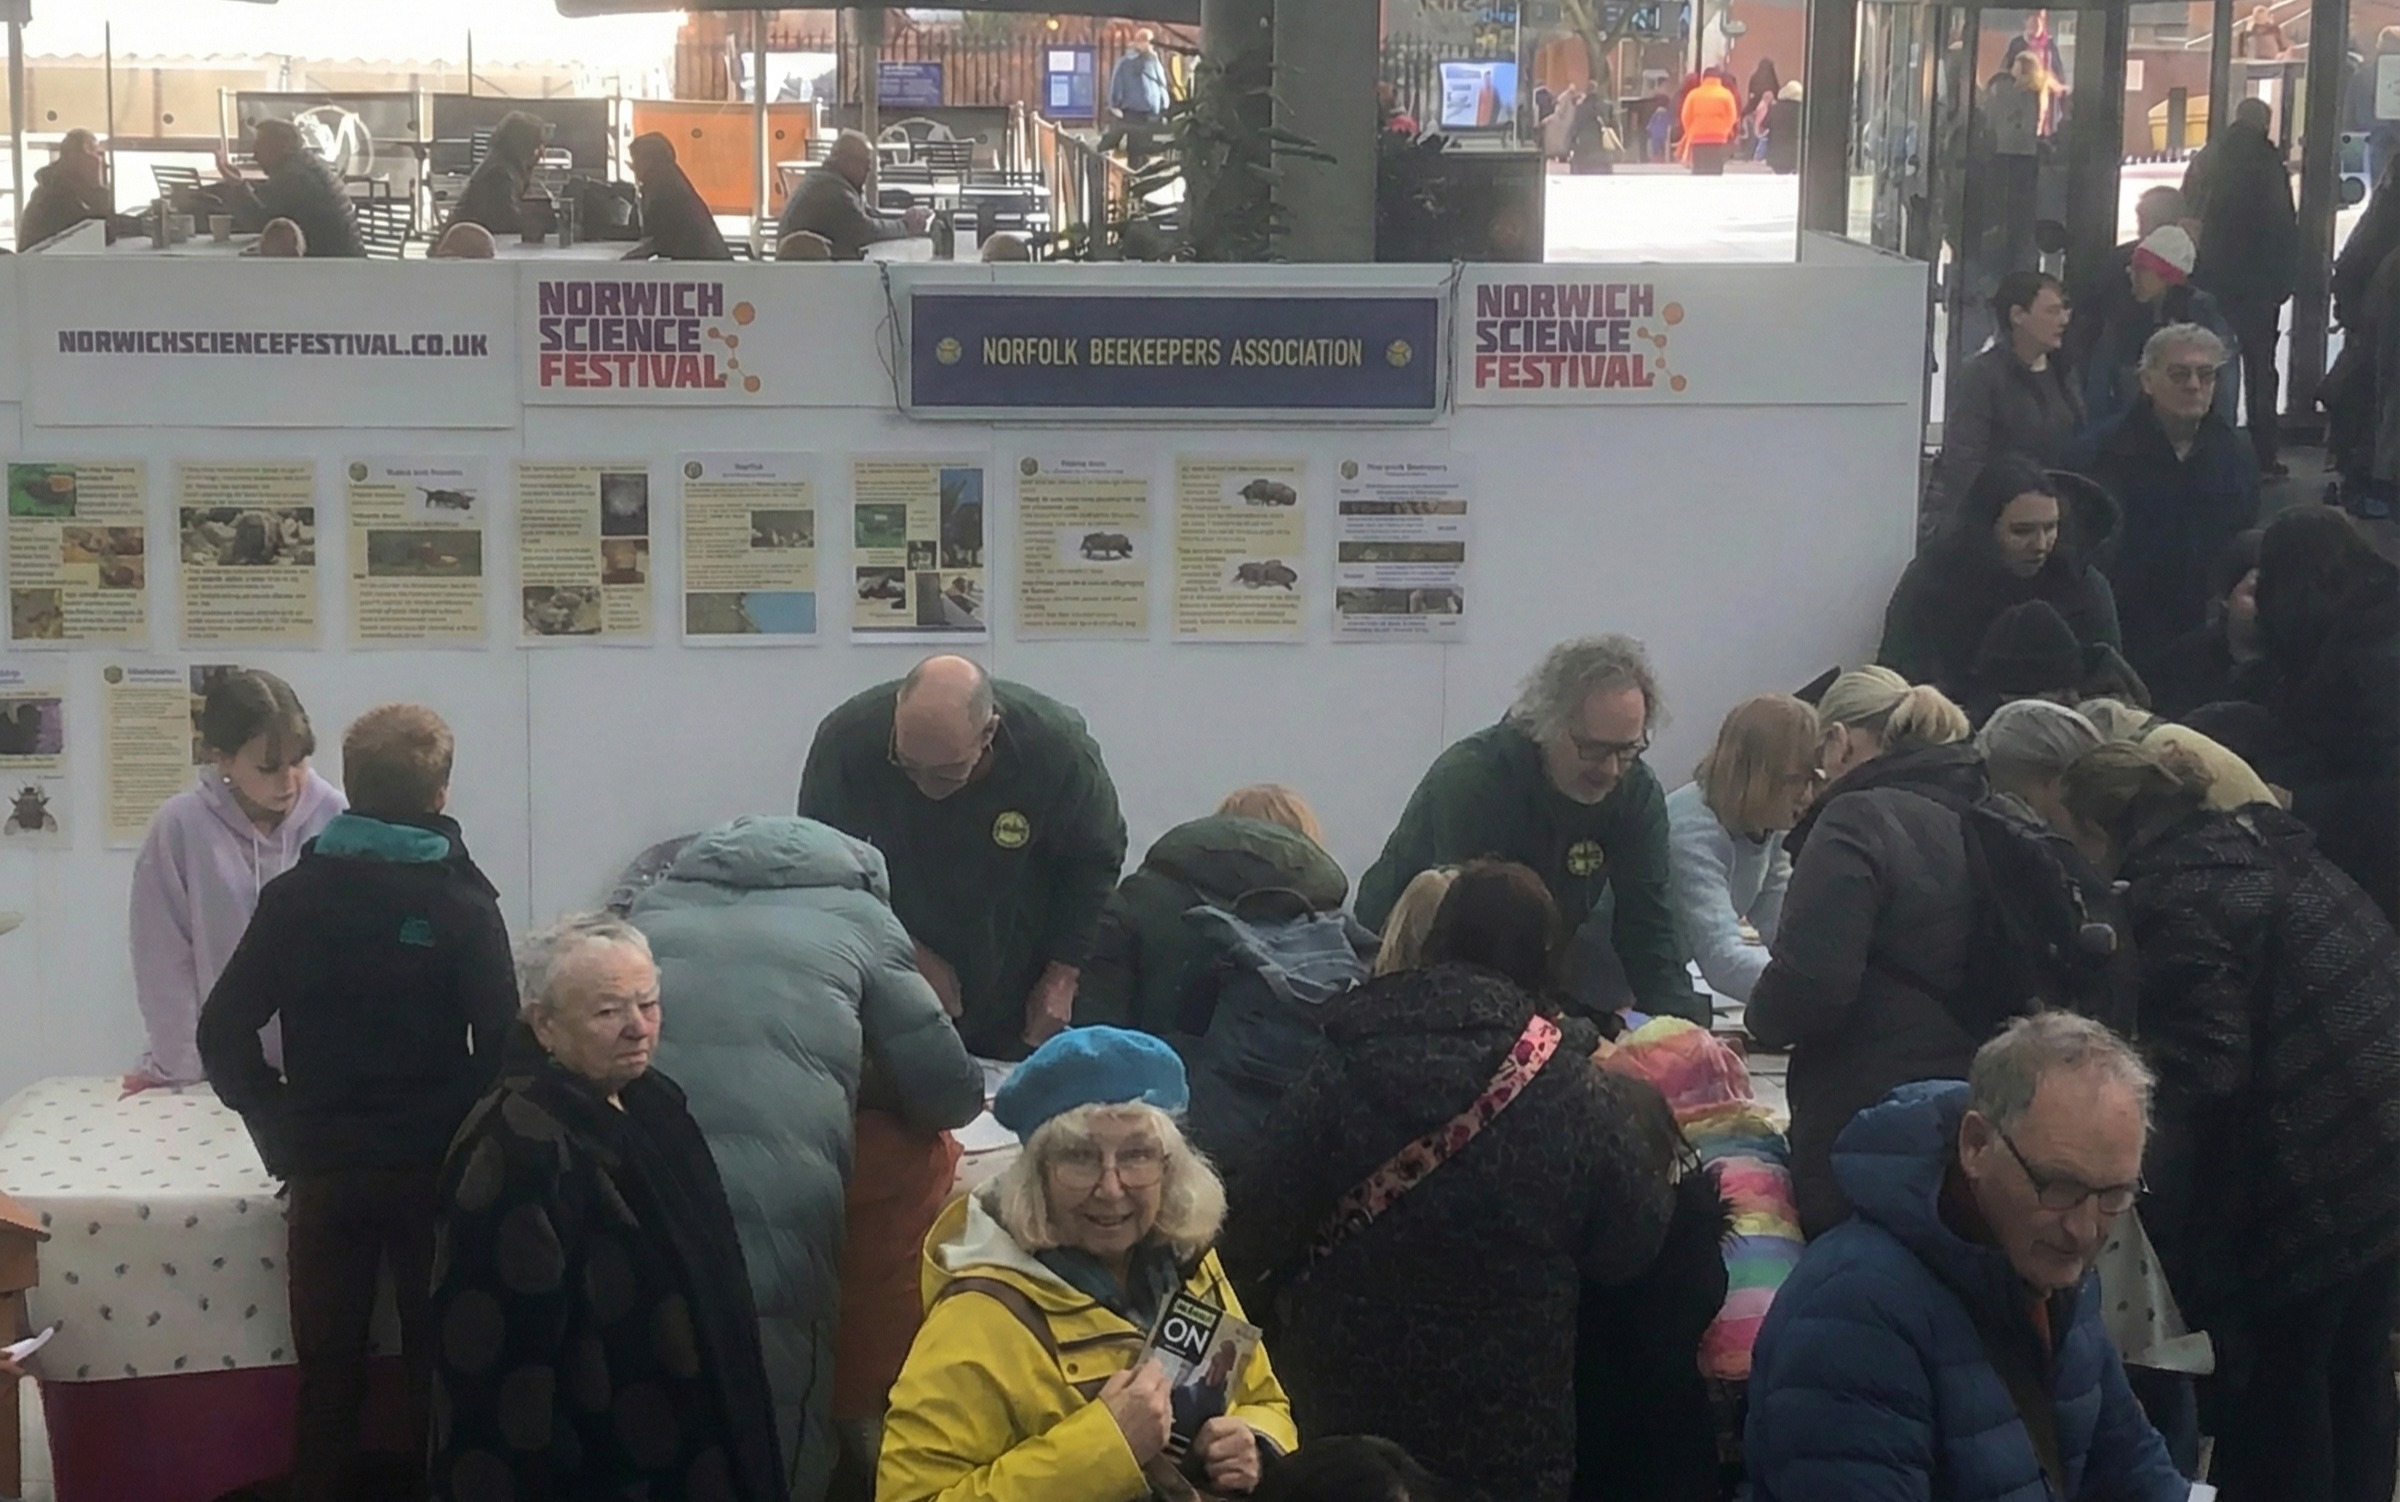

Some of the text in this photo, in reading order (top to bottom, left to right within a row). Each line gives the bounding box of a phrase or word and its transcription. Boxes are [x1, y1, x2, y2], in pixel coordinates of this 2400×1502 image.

[538, 281, 724, 317] NORWICH
[1475, 283, 1654, 318] NORWICH
[58, 330, 488, 357] NORWICHSCIENCEFESTIVAL.CO.UK
[538, 317, 702, 353] SCIENCE
[982, 337, 1362, 367] NORFOLK BEEKEEPERS ASSOCIATION
[1475, 319, 1632, 353] SCIENCE
[539, 353, 727, 389] FESTIVAL
[1474, 353, 1655, 389] FESTIVAL
[1163, 1317, 1211, 1355] ON
